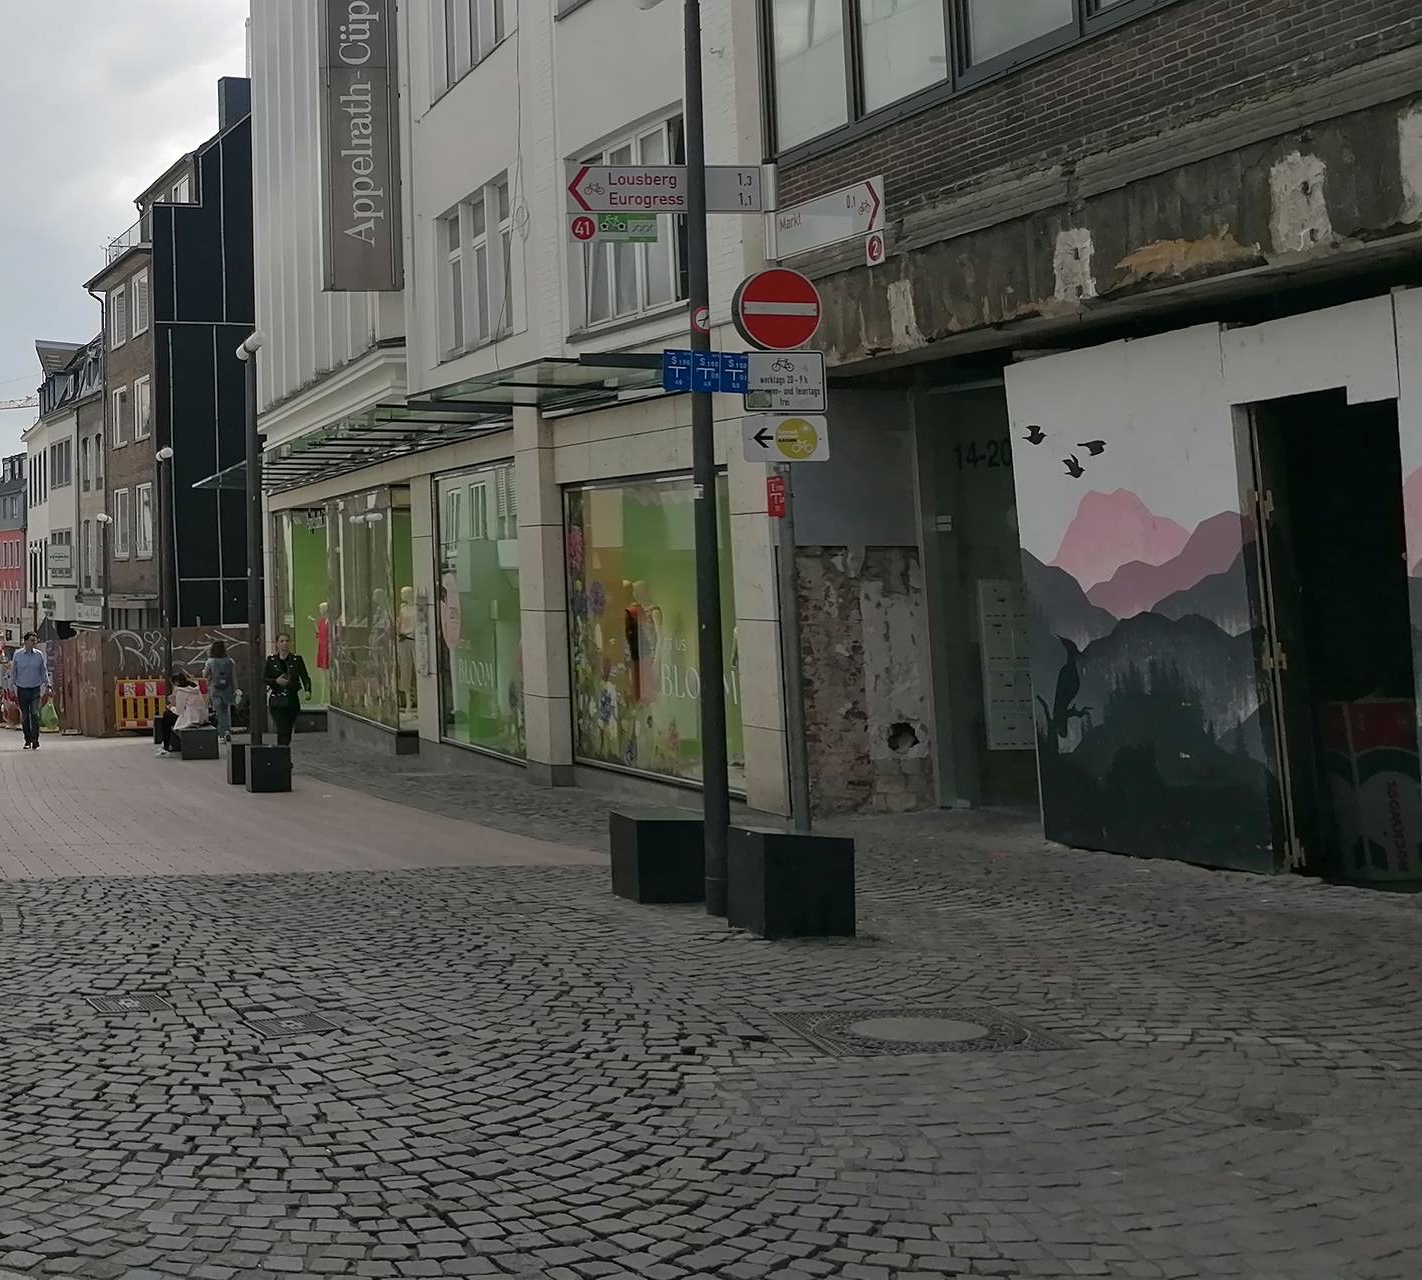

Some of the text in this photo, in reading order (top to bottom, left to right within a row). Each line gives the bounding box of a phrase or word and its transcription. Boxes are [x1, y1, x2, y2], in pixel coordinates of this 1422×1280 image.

[340, 81, 384, 247] Appelrath
[608, 172, 752, 188] Lousberg 1.3
[609, 192, 752, 208] Eurogress 1.1
[574, 221, 591, 235] 41
[779, 212, 802, 231] Markt
[872, 241, 879, 256] 2
[760, 376, 785, 385] werktags
[458, 658, 494, 688] BLOOM
[661, 663, 738, 704] BLOM
